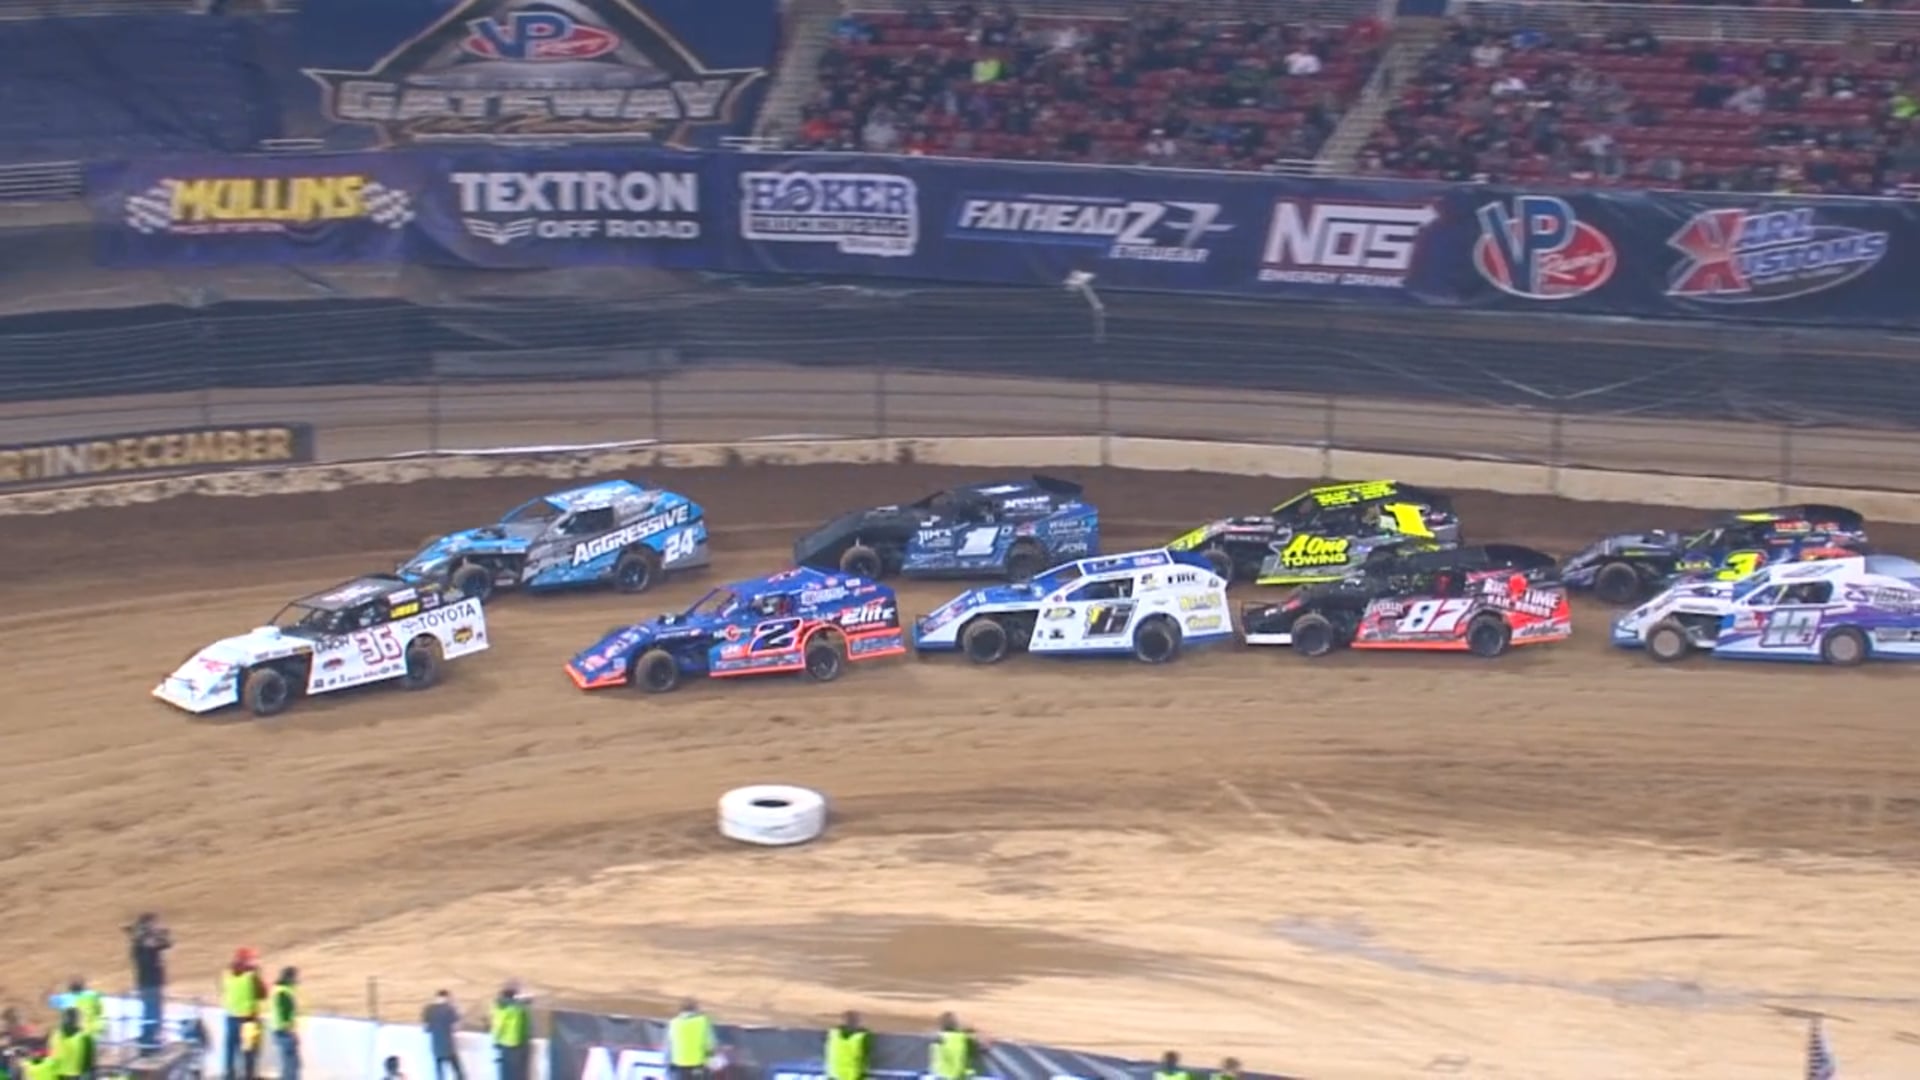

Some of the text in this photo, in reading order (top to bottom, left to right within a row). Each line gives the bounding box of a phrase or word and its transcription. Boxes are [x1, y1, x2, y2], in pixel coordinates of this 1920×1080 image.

[466, 11, 573, 59] VP
[338, 80, 731, 121] GATEWAY
[170, 176, 368, 222] MULLINS
[450, 171, 698, 213] TEXTRON
[537, 218, 699, 240] OFF ROAD
[1262, 201, 1439, 270] NOS
[1475, 194, 1577, 294] VP
[1257, 268, 1407, 288] ENERGY DRINK
[572, 503, 691, 566] AGGRESSIVE
[1383, 502, 1435, 538] 1
[664, 526, 695, 563] 24
[956, 526, 1000, 557] 1
[1281, 553, 1348, 567] TOWING
[418, 602, 477, 630] TOYOTA
[841, 602, 896, 627] Elite
[1396, 598, 1475, 634] 87
[749, 617, 804, 654] 2
